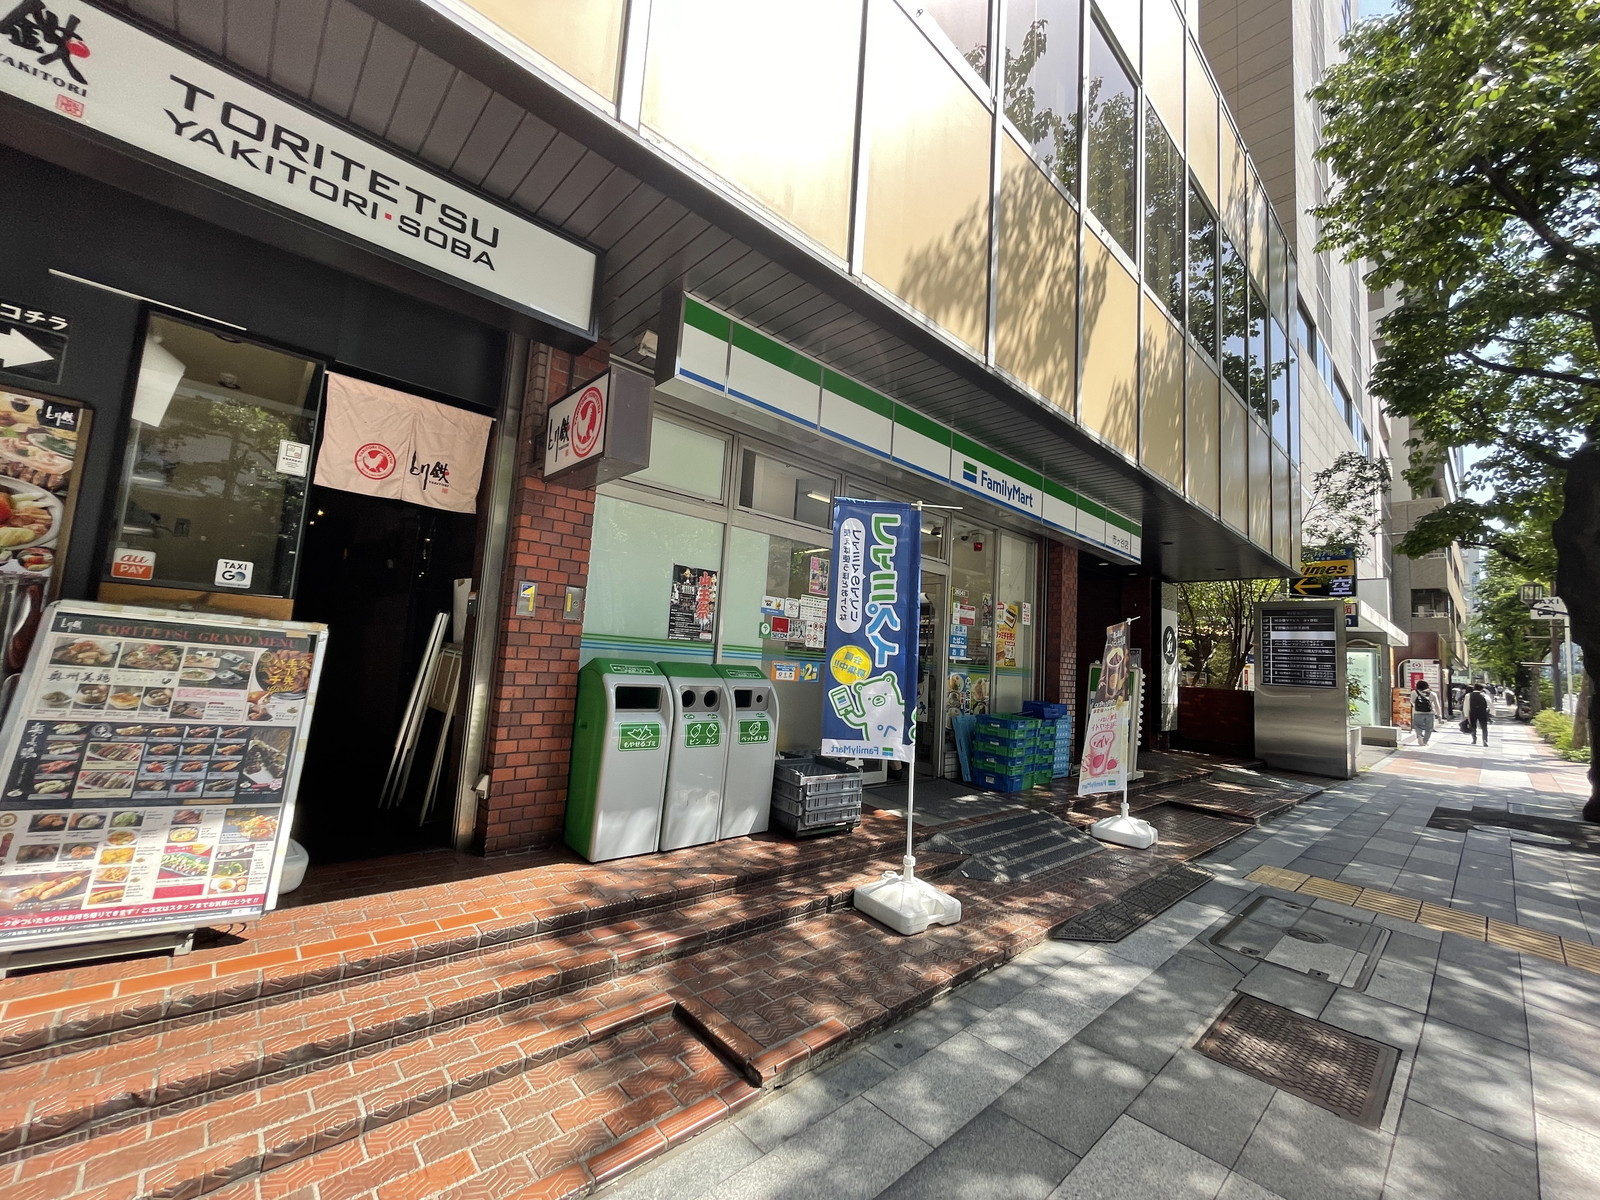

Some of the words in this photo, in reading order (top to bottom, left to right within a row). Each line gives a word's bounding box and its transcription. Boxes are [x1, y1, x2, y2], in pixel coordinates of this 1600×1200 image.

[0, 53, 87, 97] AKITORI
[169, 74, 499, 249] TORITETSU
[163, 109, 378, 221] YAKITORI
[398, 215, 496, 271] SOBA
[981, 470, 1034, 508] FamilyMart
[120, 554, 149, 564] au
[223, 561, 247, 571] TAXI
[120, 564, 147, 575] PAY
[222, 570, 246, 582] GO
[1301, 564, 1348, 576] imes
[1329, 577, 1353, 596] 空
[696, 571, 712, 619] 山王祭
[198, 632, 253, 646] GRAND
[258, 636, 297, 649] MENU
[624, 740, 657, 748] もやせるゴミ
[741, 734, 767, 742] ペットボトル
